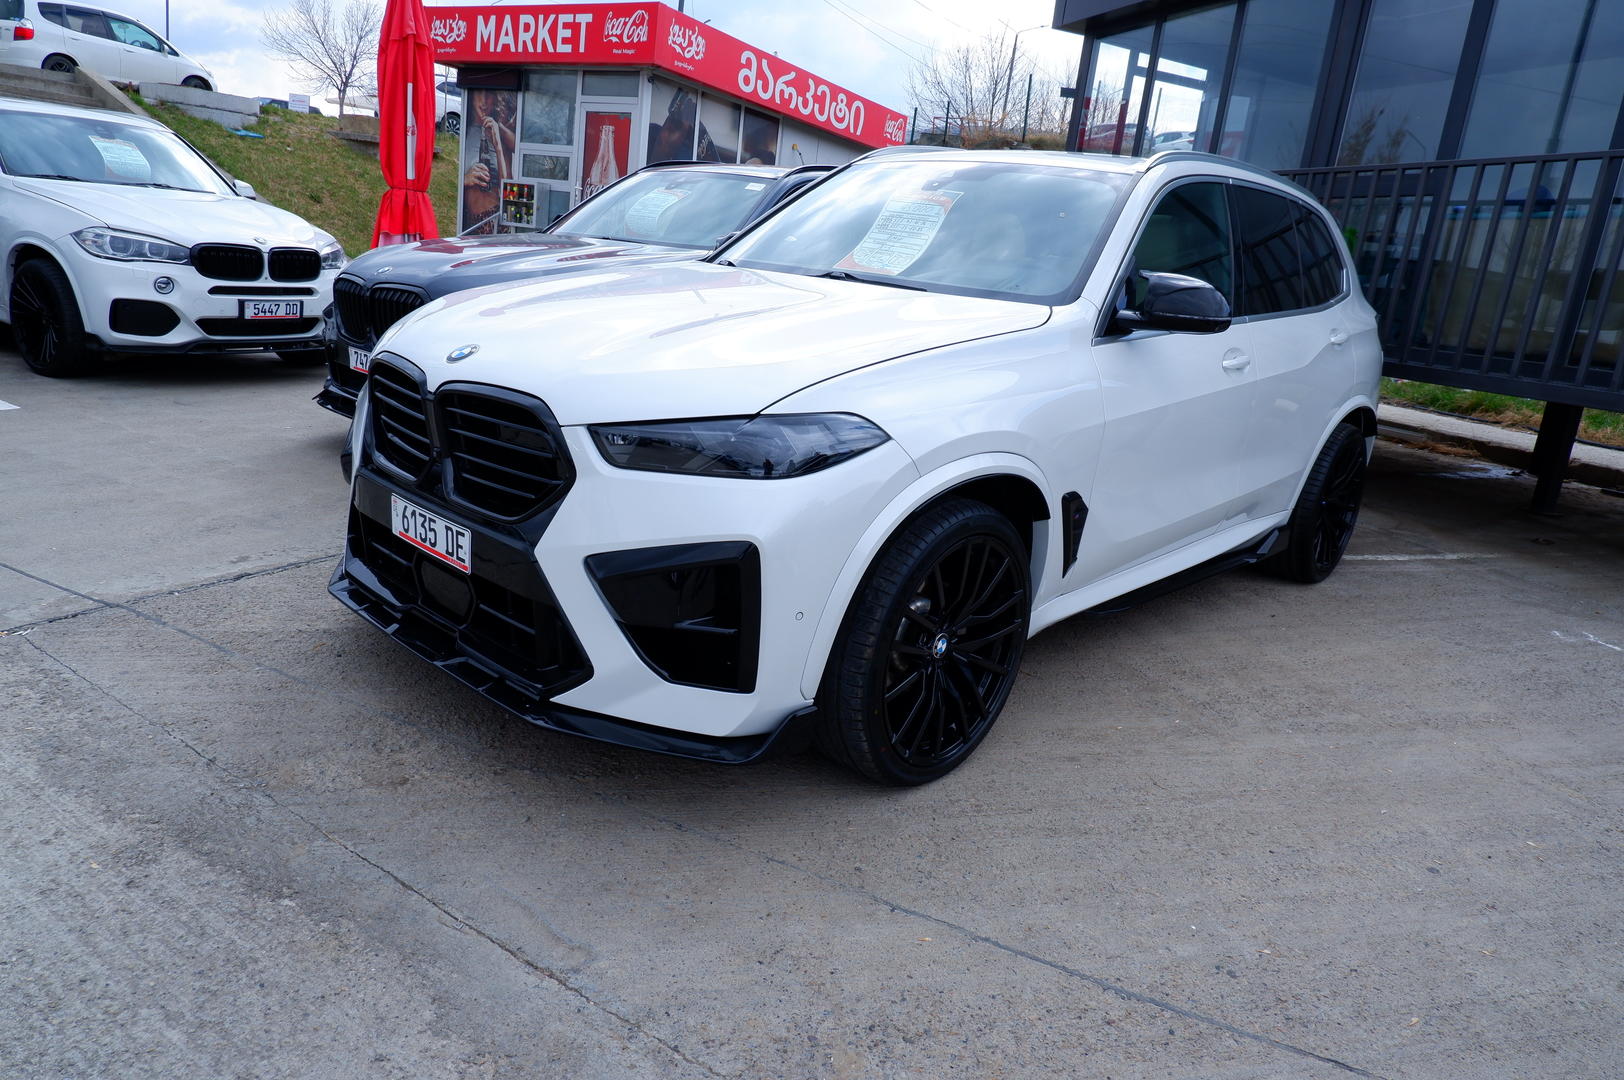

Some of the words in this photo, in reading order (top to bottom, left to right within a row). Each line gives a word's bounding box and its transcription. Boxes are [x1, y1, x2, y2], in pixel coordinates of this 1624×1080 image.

[475, 13, 593, 53] MARKET
[603, 9, 648, 44] Coca-Cola
[738, 50, 865, 136] მარკეტი
[253, 303, 281, 316] 5447
[285, 303, 298, 315] DD
[354, 351, 370, 370] 747
[402, 505, 437, 548] 6135
[445, 524, 466, 564] DE
